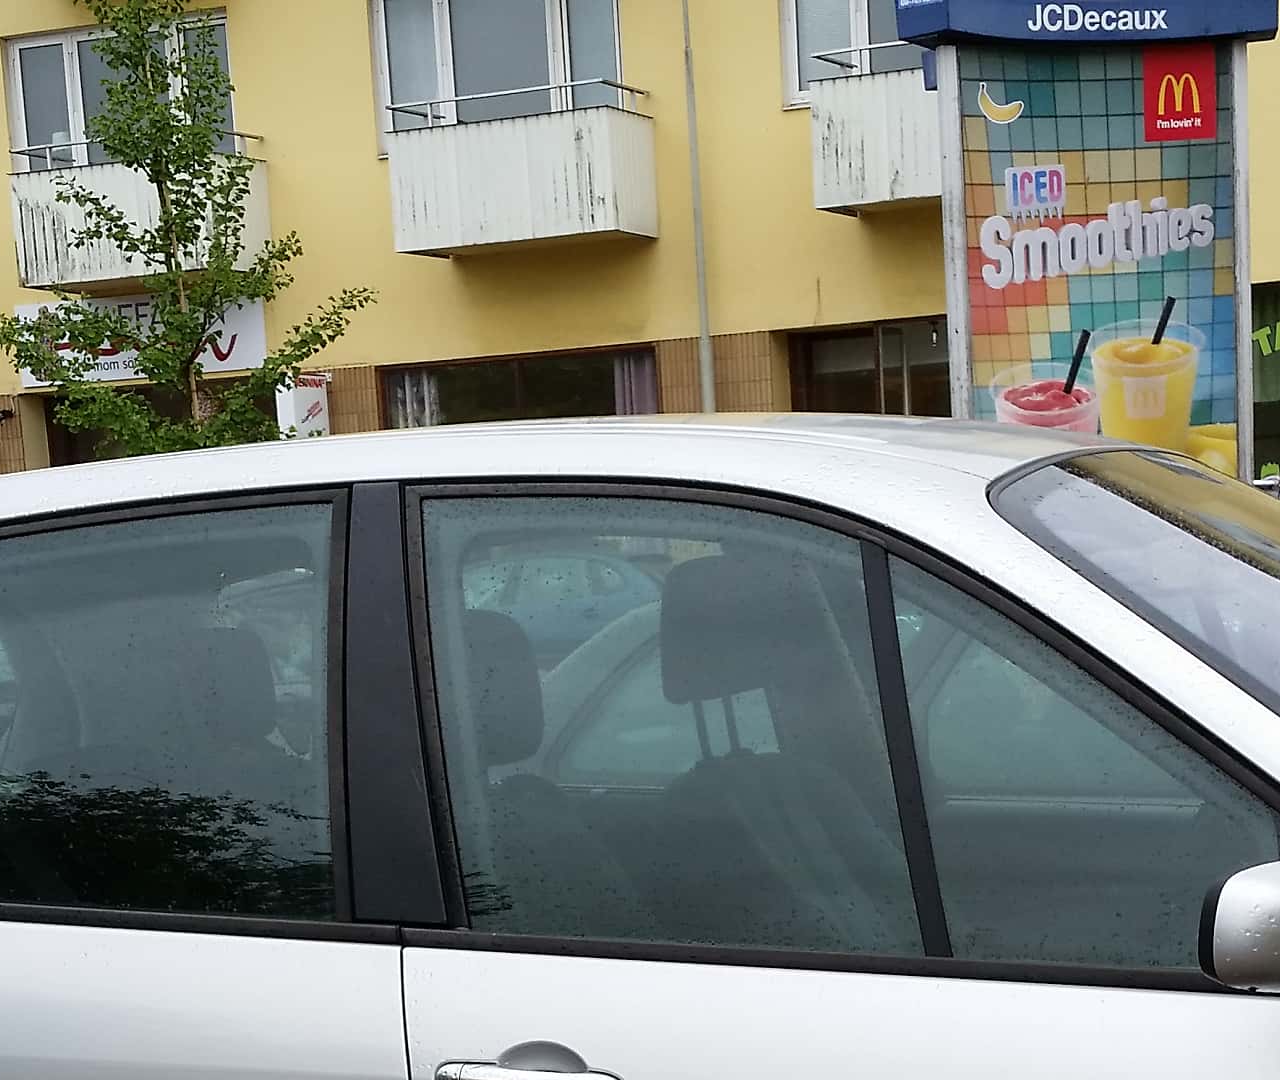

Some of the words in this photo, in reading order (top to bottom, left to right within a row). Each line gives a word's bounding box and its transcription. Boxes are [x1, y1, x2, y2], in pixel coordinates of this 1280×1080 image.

[1027, 4, 1168, 32] JCDecaux
[1156, 119, 1170, 129] I'm
[1194, 117, 1202, 127] it
[1012, 169, 1062, 207] ICED
[980, 196, 1214, 289] Smoothies
